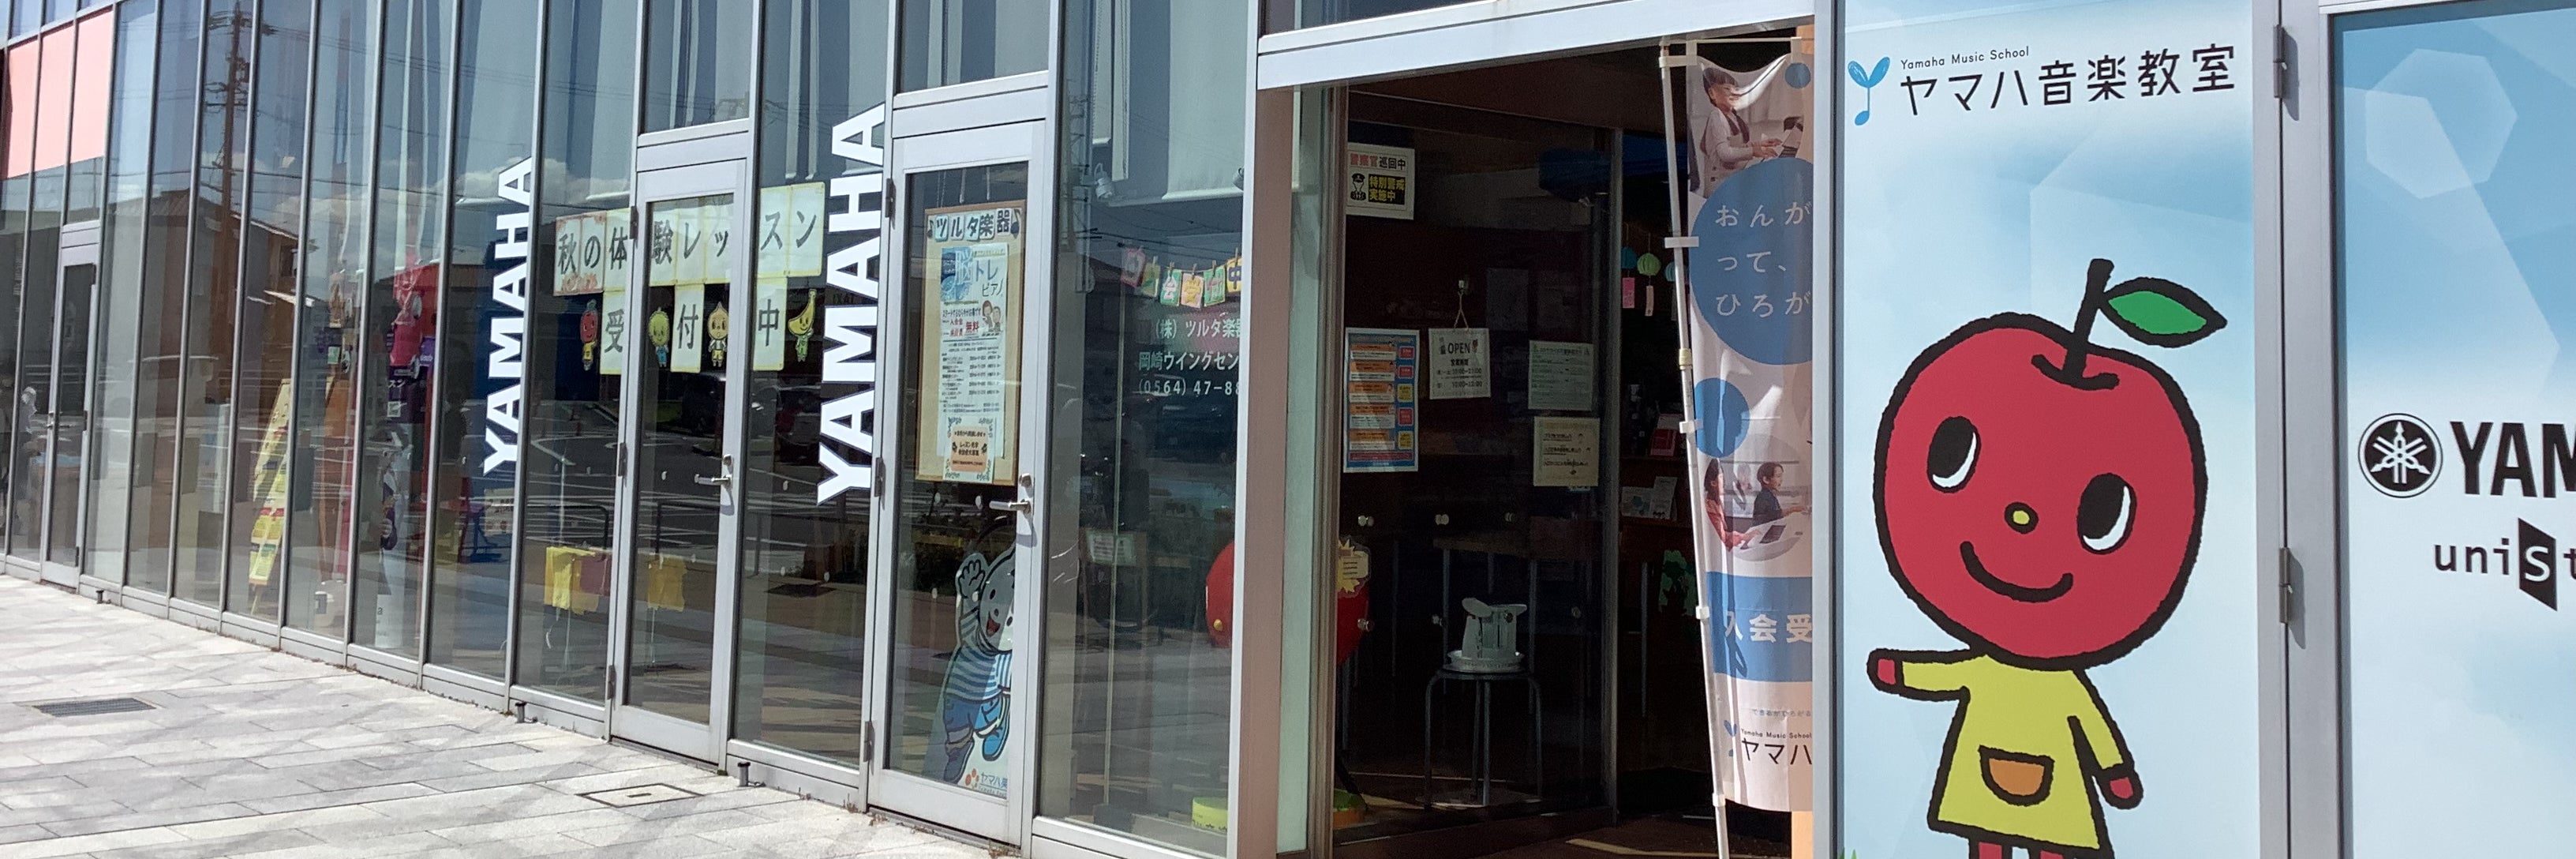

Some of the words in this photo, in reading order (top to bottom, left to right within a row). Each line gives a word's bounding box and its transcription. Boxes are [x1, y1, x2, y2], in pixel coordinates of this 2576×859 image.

[1900, 56, 1945, 69] Yamaha
[1952, 51, 1984, 65] Music
[1990, 46, 2029, 60] School
[1900, 43, 2234, 115] ヤマハ音楽教室
[936, 209, 1010, 238] ツルタ楽器
[1715, 201, 1812, 229] おんが
[484, 156, 532, 475] YAMAHA
[817, 102, 885, 505] YAMAHA
[1716, 291, 1812, 317] ひろが
[1447, 343, 1470, 354] OPEN
[2450, 421, 2576, 498] YAM
[1741, 729, 1763, 737] Yamaha
[1742, 737, 1812, 765] ヤマハ
